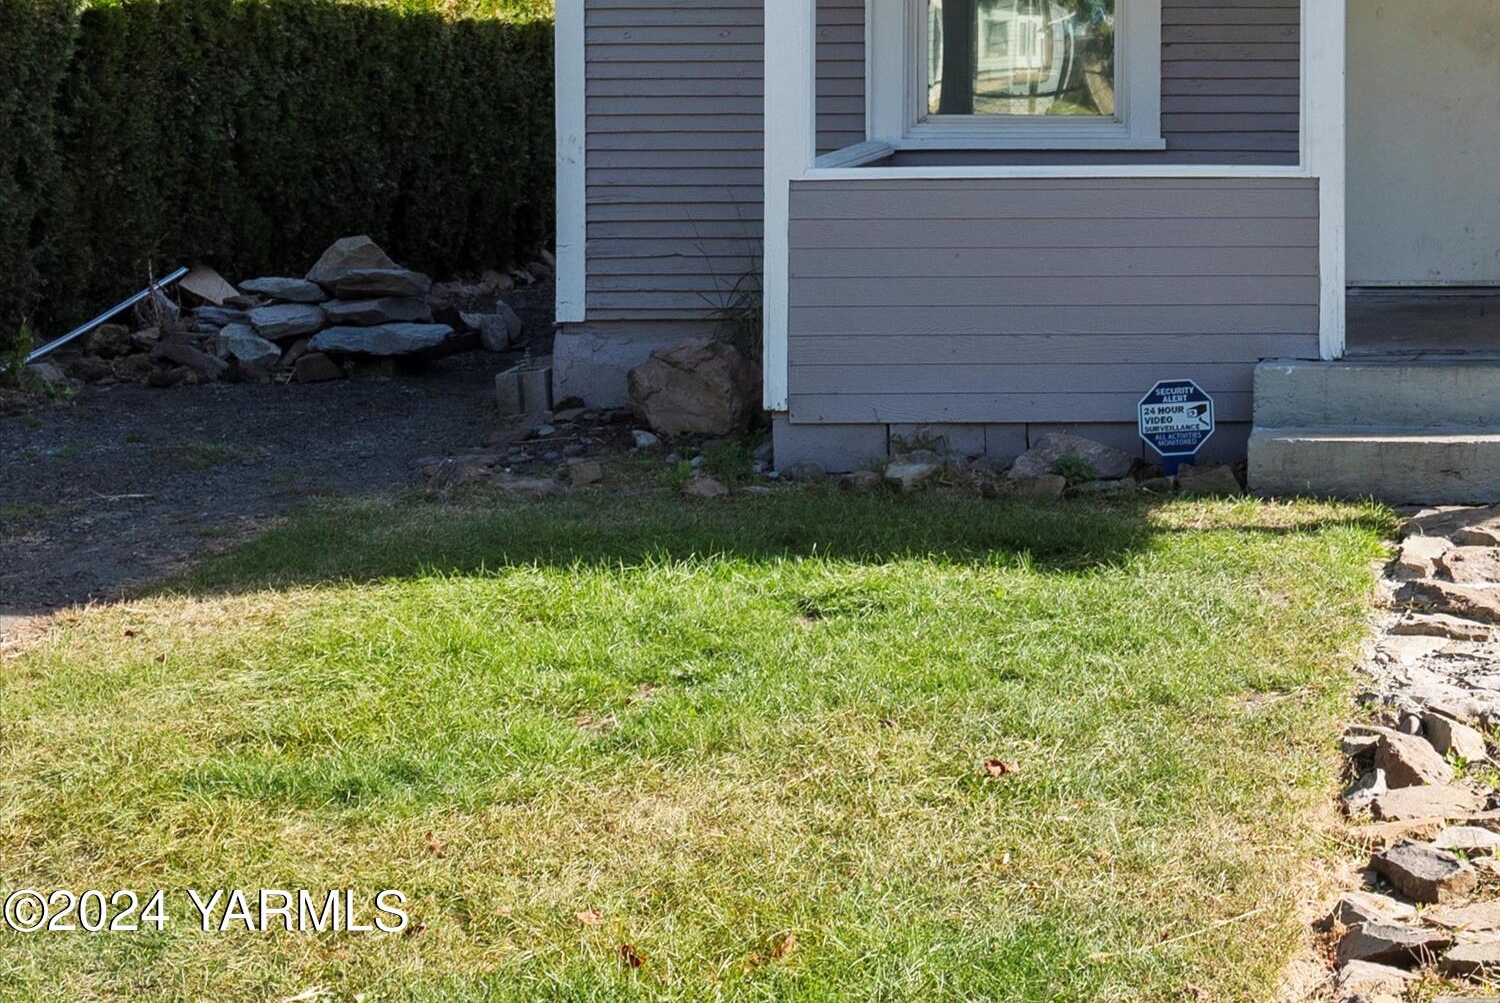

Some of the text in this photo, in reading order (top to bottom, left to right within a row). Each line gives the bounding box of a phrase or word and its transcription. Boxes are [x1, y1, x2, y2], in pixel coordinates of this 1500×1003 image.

[1155, 387, 1194, 395] SECURITY
[1163, 395, 1187, 403] ALERT
[1158, 406, 1184, 414] HOUR
[1144, 416, 1173, 424] VIDEO
[1145, 424, 1200, 433] SURVEILLANCE
